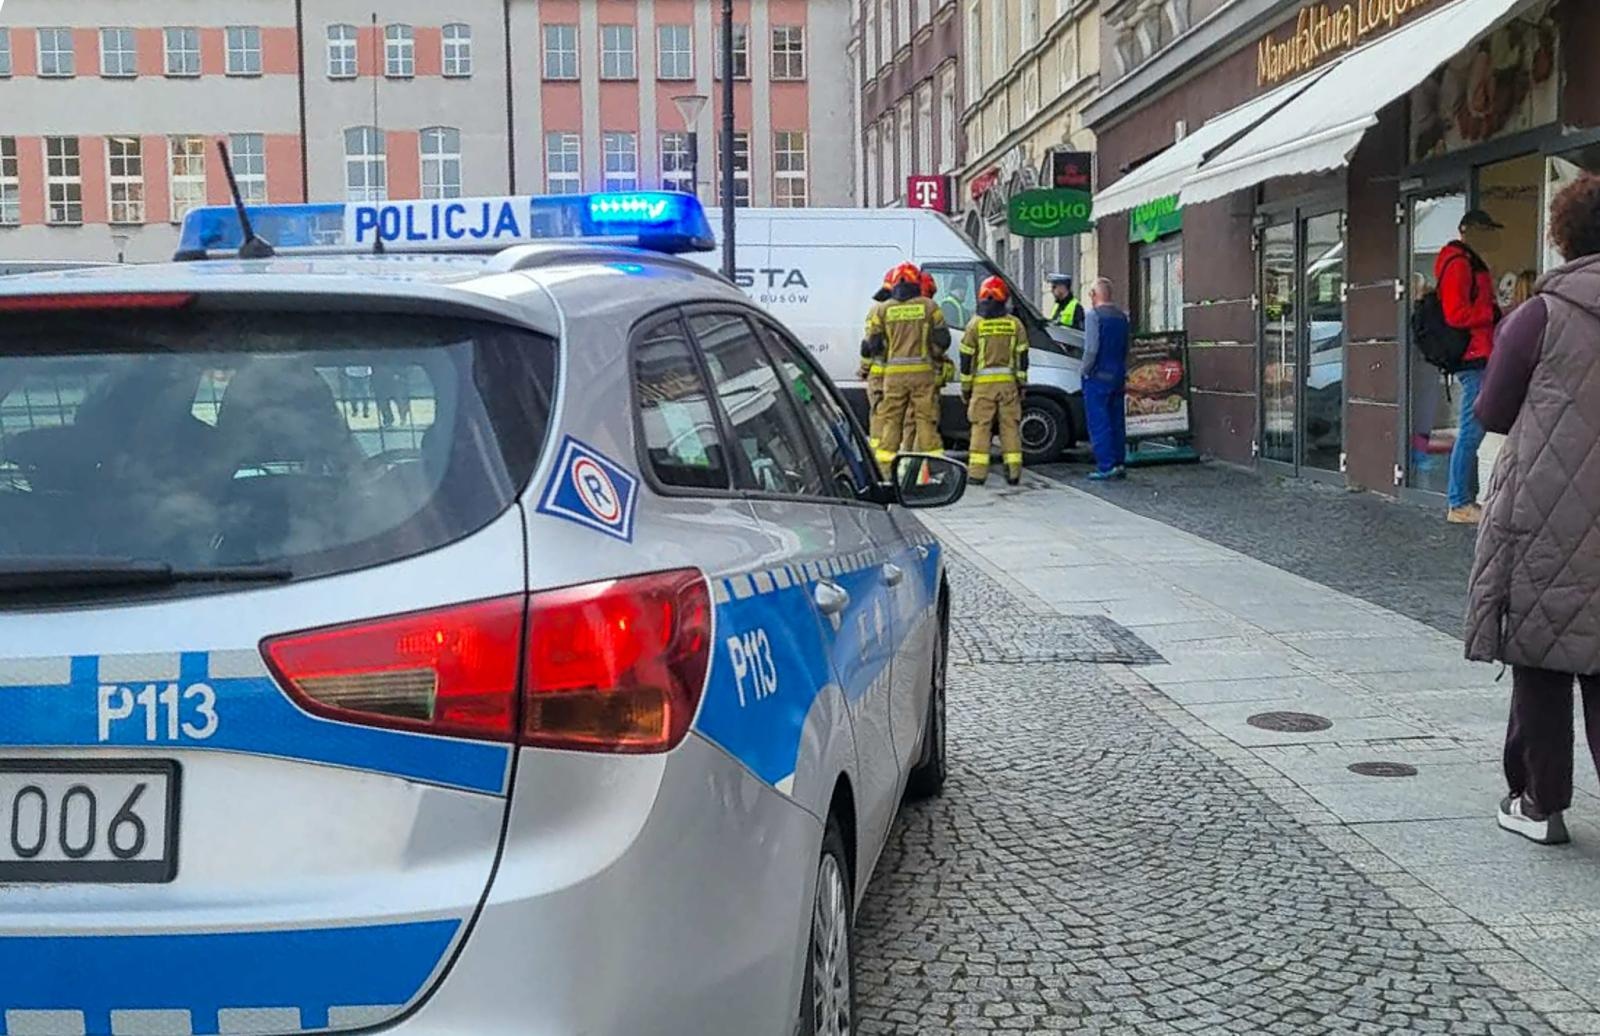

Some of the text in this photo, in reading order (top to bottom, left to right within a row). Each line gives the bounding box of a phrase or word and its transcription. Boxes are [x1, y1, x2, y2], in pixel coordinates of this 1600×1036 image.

[1256, 4, 1352, 86] Manufaktura
[916, 181, 938, 207] T
[1019, 200, 1087, 220] żabka
[356, 201, 521, 242] POLICJA
[584, 475, 611, 507] R
[727, 628, 778, 708] P113
[98, 683, 219, 742] P113
[11, 783, 147, 858] 006
